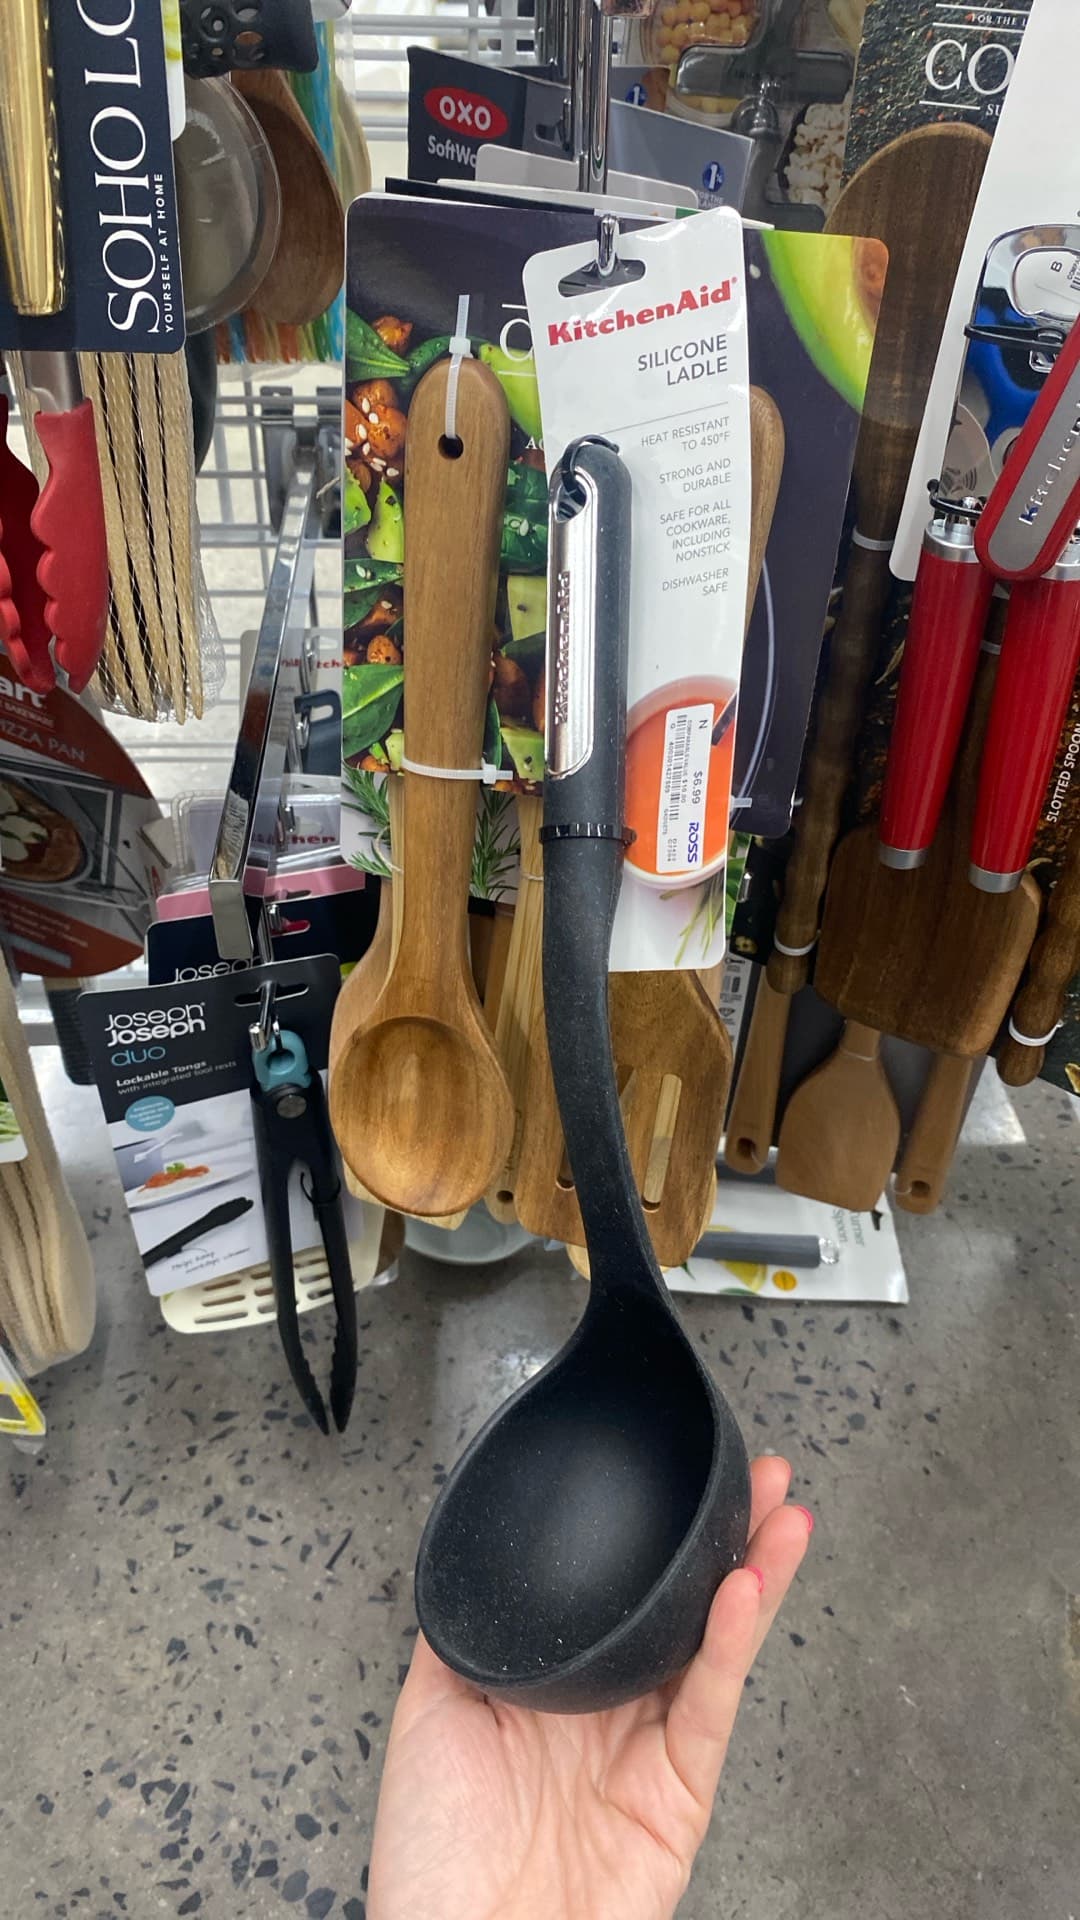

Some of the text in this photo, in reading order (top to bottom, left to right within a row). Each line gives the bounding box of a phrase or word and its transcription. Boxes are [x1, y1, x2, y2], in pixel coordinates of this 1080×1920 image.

[995, 16, 1017, 26] THE
[439, 95, 492, 132] OXO
[89, 106, 160, 334] SOHO
[154, 173, 174, 333] YOURSELF AT HOME
[1051, 261, 1063, 272] B
[547, 279, 732, 347] KitchenAid
[637, 334, 728, 372] SILICONE
[666, 357, 728, 387] LADLE
[641, 416, 730, 449] HEAT RESISTANT
[681, 431, 731, 453] TO 450°F
[659, 457, 731, 486] STRONG AND
[1019, 403, 1080, 525] Kitchen
[682, 473, 732, 494] DURABLE
[659, 499, 732, 526] SAFE FOR ALL
[666, 513, 731, 538] COOKWARE,
[672, 528, 731, 550] INCLUDING
[675, 541, 730, 564] NONSTICK
[662, 568, 729, 592] DISHWASHER
[702, 581, 728, 597] SAFE
[698, 719, 709, 730] N
[691, 771, 703, 805] $6.99
[1047, 769, 1071, 824] SLOTTED
[687, 821, 700, 864] ROSS
[104, 1003, 204, 1032] Joseph
[107, 1018, 206, 1047] Joseph
[111, 1046, 166, 1066] duo
[116, 1060, 207, 1087] Lockable Tongs
[118, 1061, 237, 1095] with integrated tool rests
